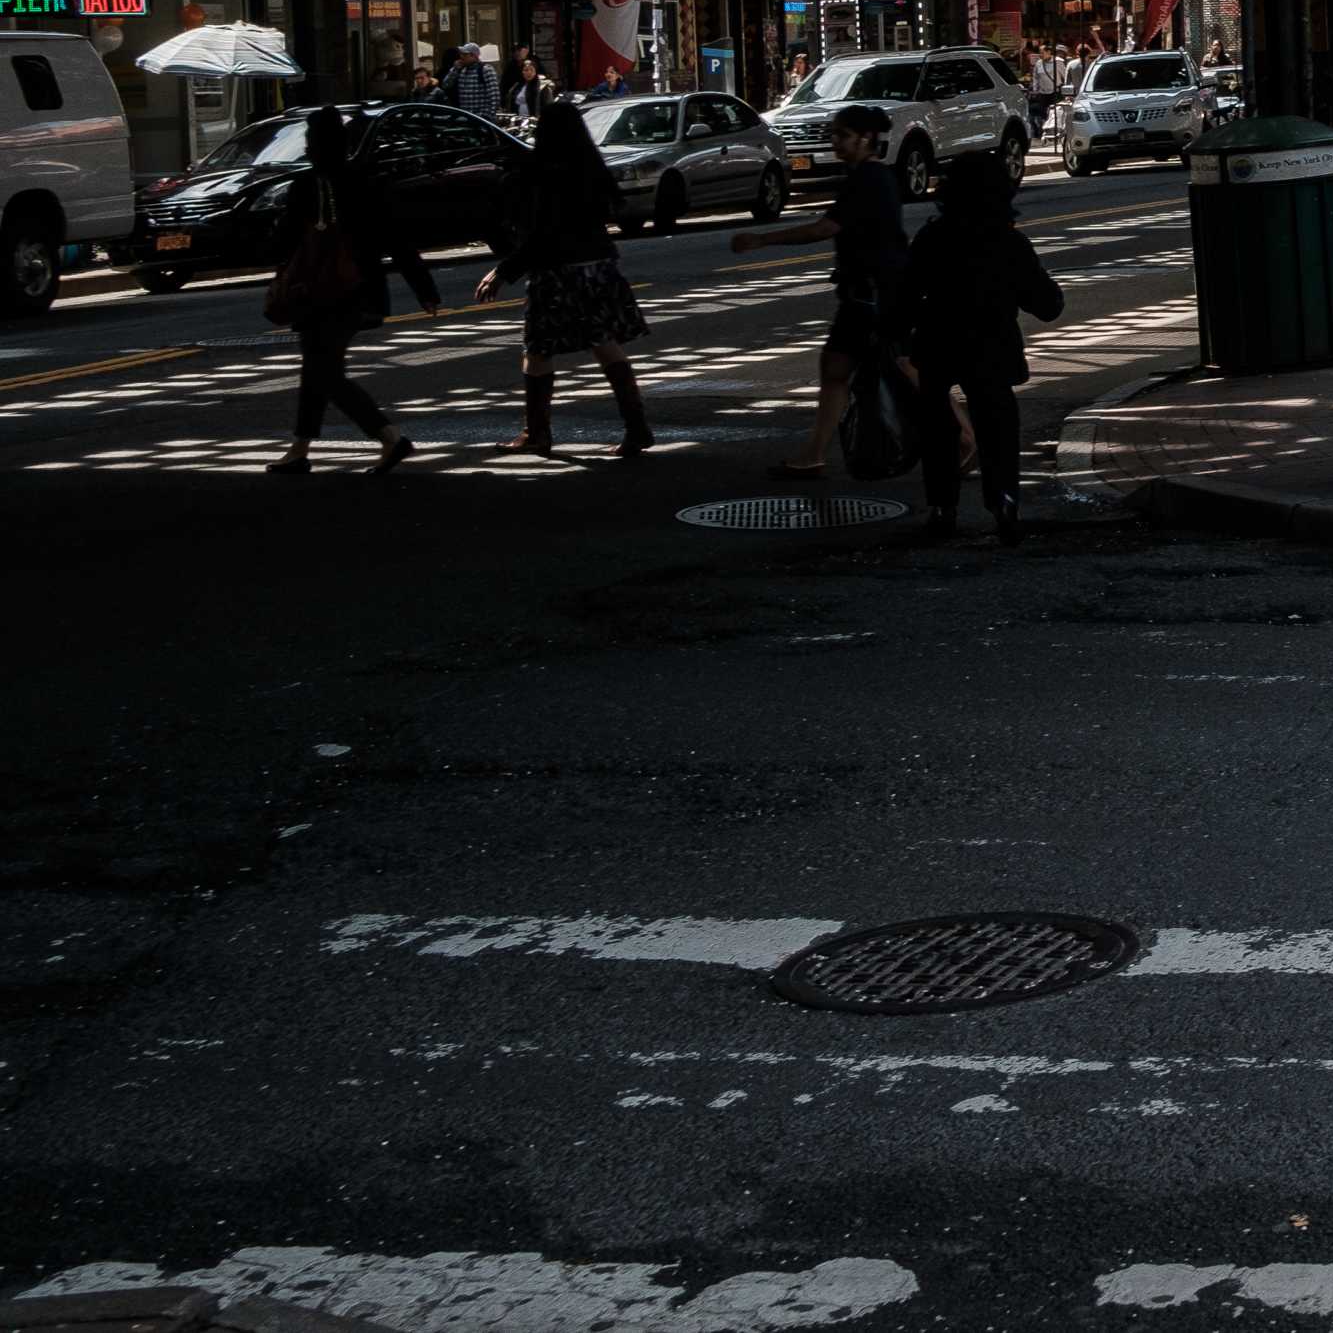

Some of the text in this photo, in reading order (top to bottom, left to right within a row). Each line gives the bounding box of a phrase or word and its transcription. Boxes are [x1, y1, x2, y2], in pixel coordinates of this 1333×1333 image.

[711, 58, 720, 73] P
[1258, 154, 1333, 170] Keep New York City
